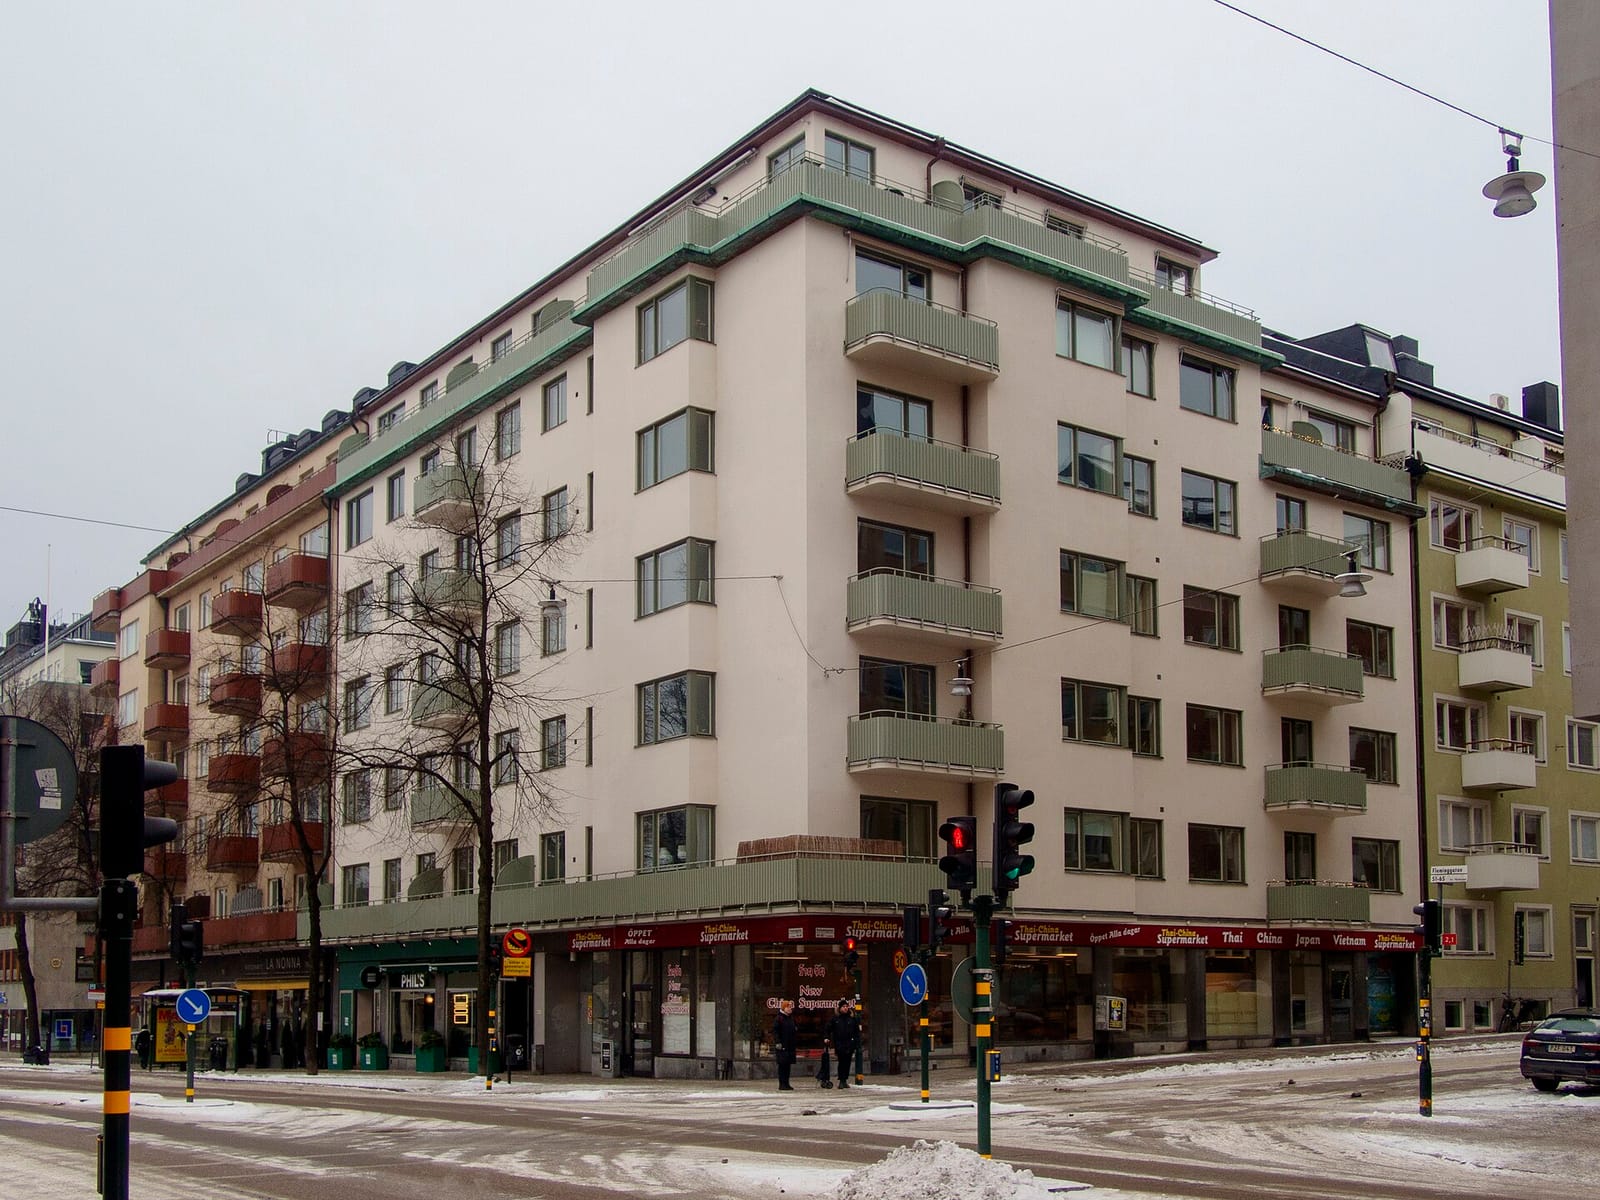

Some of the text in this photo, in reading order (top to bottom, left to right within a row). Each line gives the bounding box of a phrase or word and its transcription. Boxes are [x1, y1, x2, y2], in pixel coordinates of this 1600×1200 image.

[703, 923, 736, 933] Thai-China
[851, 920, 898, 930] Thai-China
[955, 926, 970, 935] Alla
[1019, 924, 1059, 933] Thai-China
[575, 932, 601, 940] Thai-China
[627, 928, 653, 937] ÖPPET
[700, 929, 748, 944] Supermarket
[845, 926, 904, 940] Supermark
[1014, 930, 1073, 943] Supermarket
[1089, 927, 1141, 943] Öppet Alla dagar
[1161, 928, 1196, 936] Thai-China
[1377, 934, 1406, 942] Thai-China
[572, 938, 611, 950] Supermarket
[1156, 934, 1208, 946] Supermarket
[1222, 931, 1366, 947] Thai China Japan Vietnam
[1374, 939, 1415, 950] Supermarket
[895, 955, 904, 968] 30
[401, 974, 425, 988] PHIL'S
[799, 985, 823, 997] New
